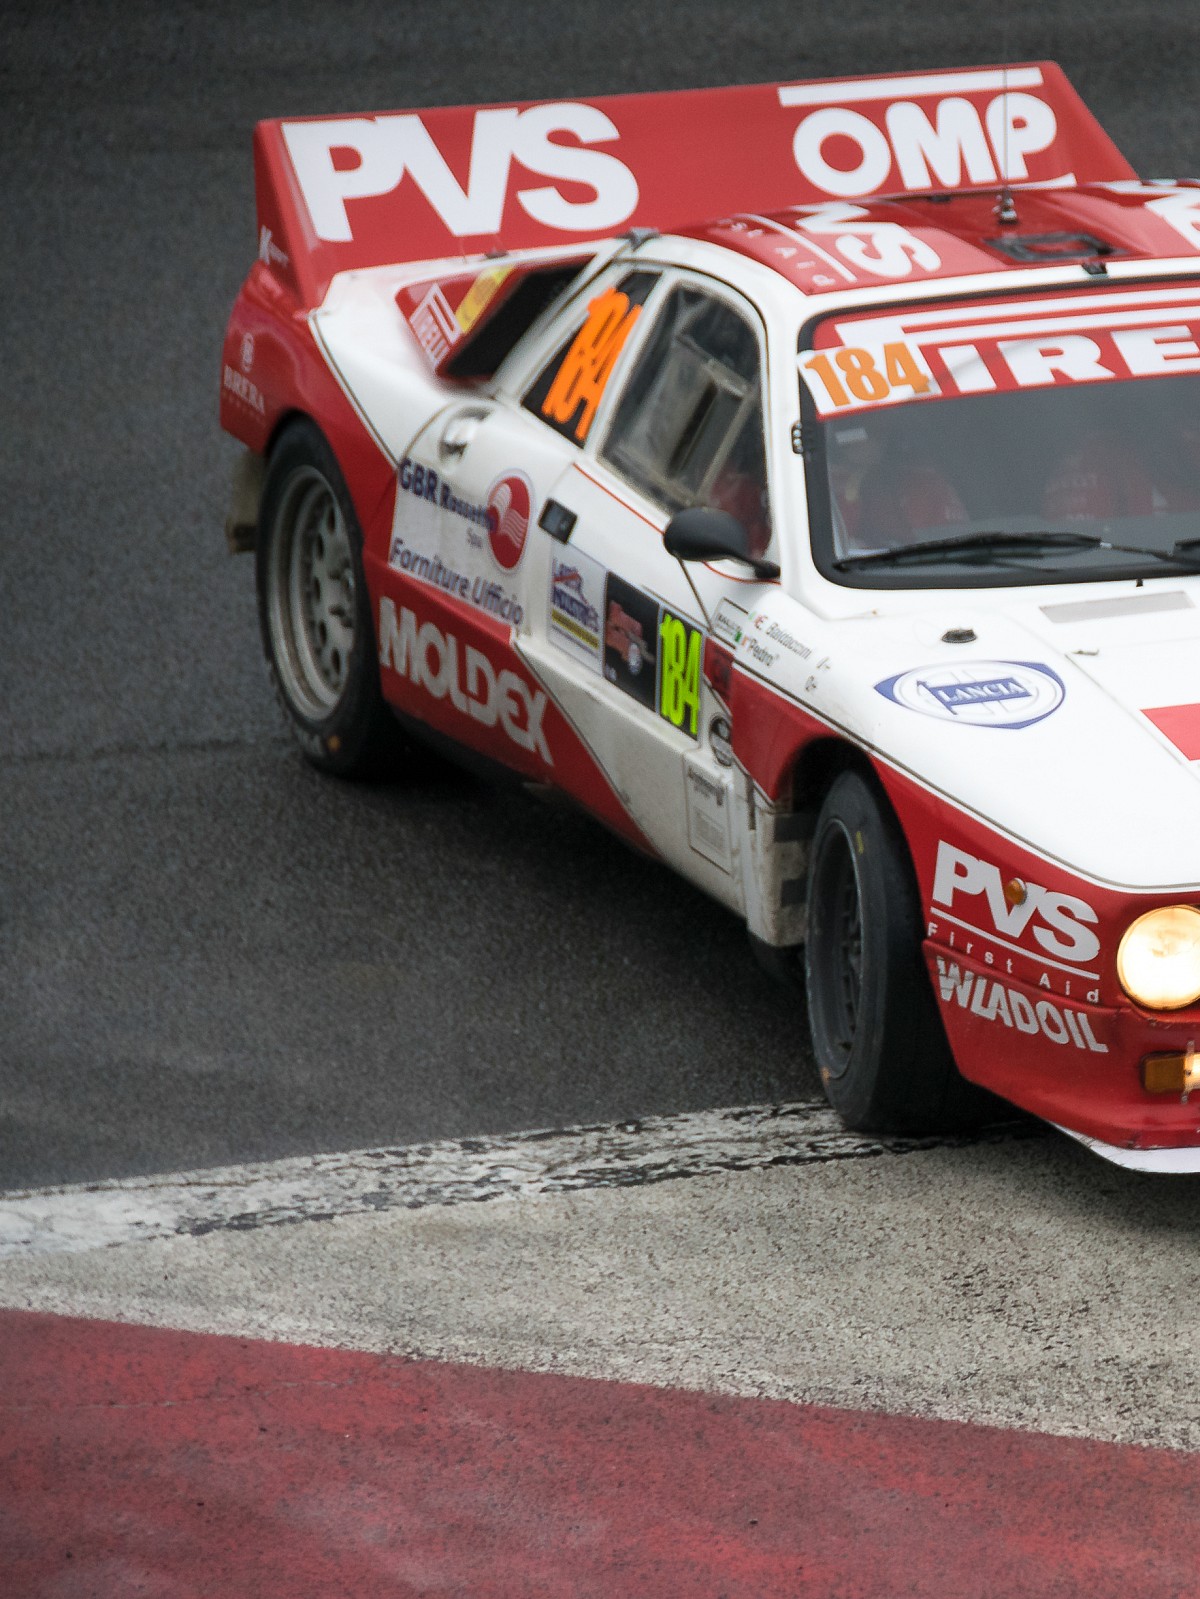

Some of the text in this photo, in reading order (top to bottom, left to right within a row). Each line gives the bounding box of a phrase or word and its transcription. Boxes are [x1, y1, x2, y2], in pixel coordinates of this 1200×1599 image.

[281, 102, 639, 243] PVS
[792, 91, 1057, 198] OMP
[803, 340, 930, 408] 184
[399, 456, 438, 504] GBR
[389, 537, 470, 598] Forniture
[471, 576, 524, 626] Ufficio
[378, 595, 556, 767] MOLDEX
[659, 613, 701, 735] 184
[937, 680, 1026, 703] LANCIA
[932, 839, 1101, 963] PVS
[927, 922, 1100, 1003] First Aid
[936, 955, 1110, 1054] WLADOIL
